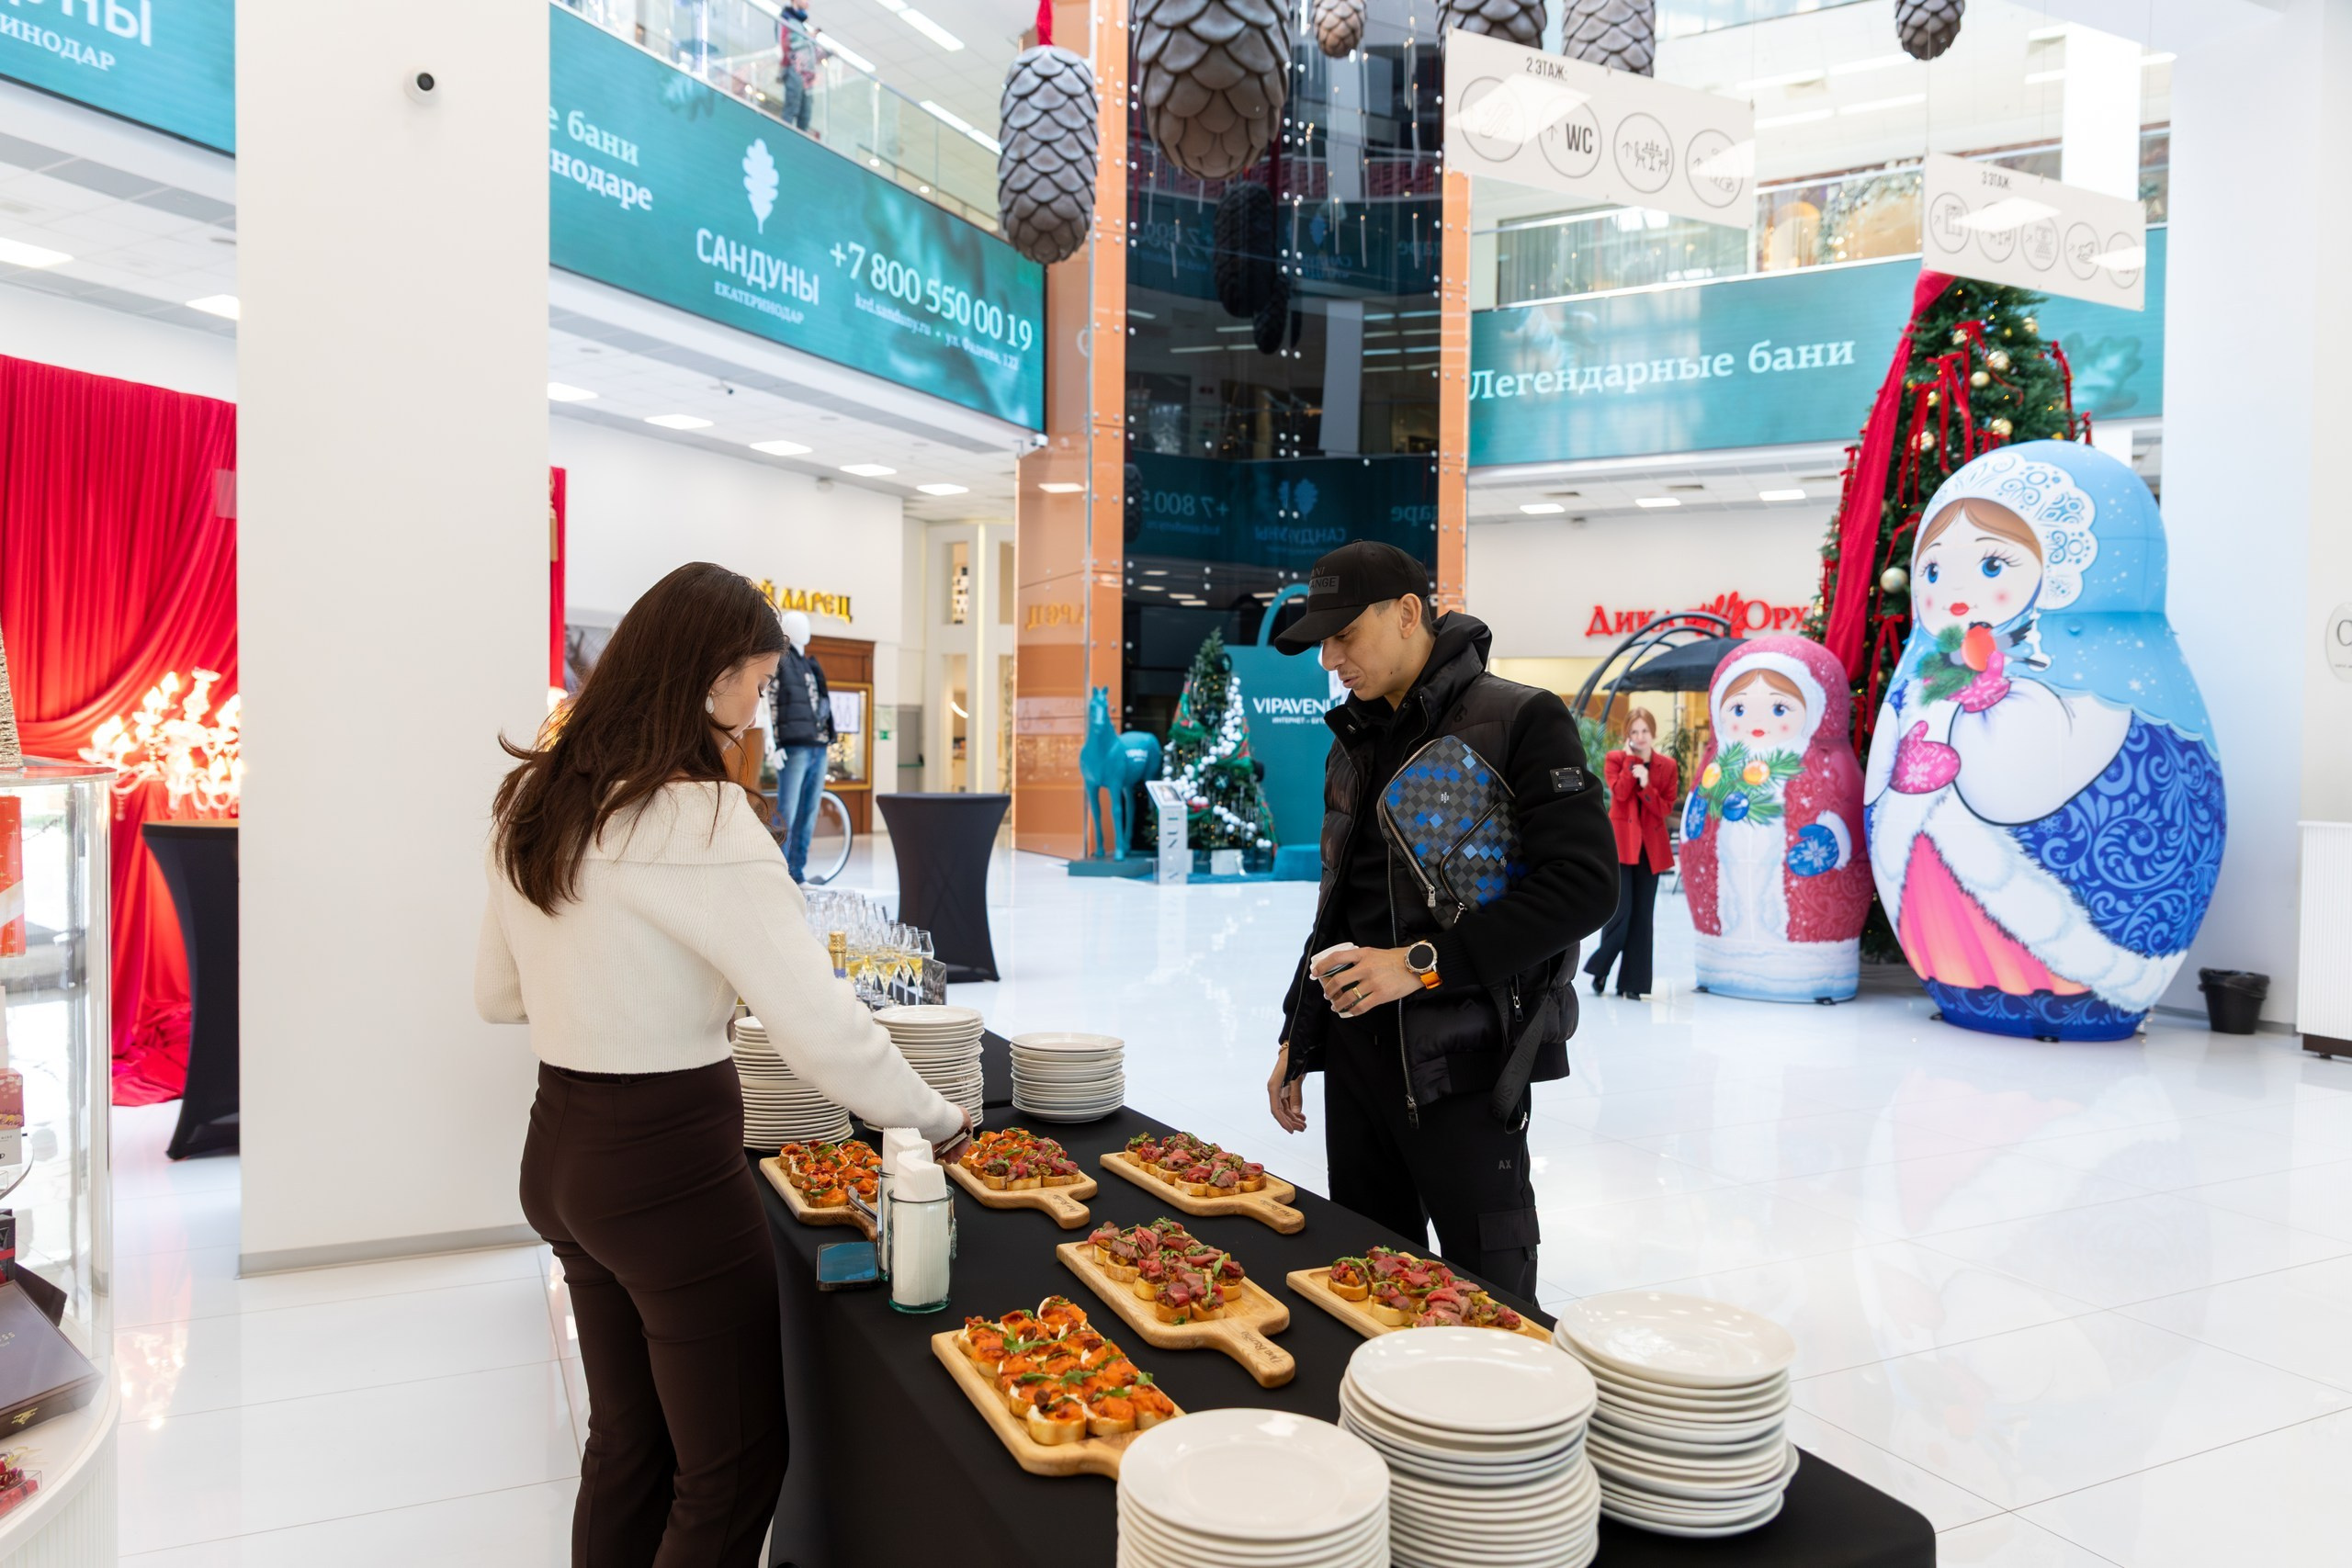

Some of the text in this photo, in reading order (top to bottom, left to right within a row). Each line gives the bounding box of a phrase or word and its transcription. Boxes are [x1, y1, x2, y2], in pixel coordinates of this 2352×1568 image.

[0, 13, 116, 72] ИНОДАР
[8, 0, 152, 47] НЫ
[1526, 56, 1567, 81] 2 ЭТАЖ:
[568, 109, 639, 167] бани
[1566, 122, 1593, 154] WC
[695, 227, 820, 306] САНДУНЫ
[830, 241, 865, 280] +7
[870, 253, 922, 305] 800
[925, 278, 971, 326] 550
[974, 299, 1002, 340] 00
[1007, 313, 1033, 351] 19
[1470, 340, 1856, 400] Легендарные бани
[1498, 1160, 1512, 1170] AX
